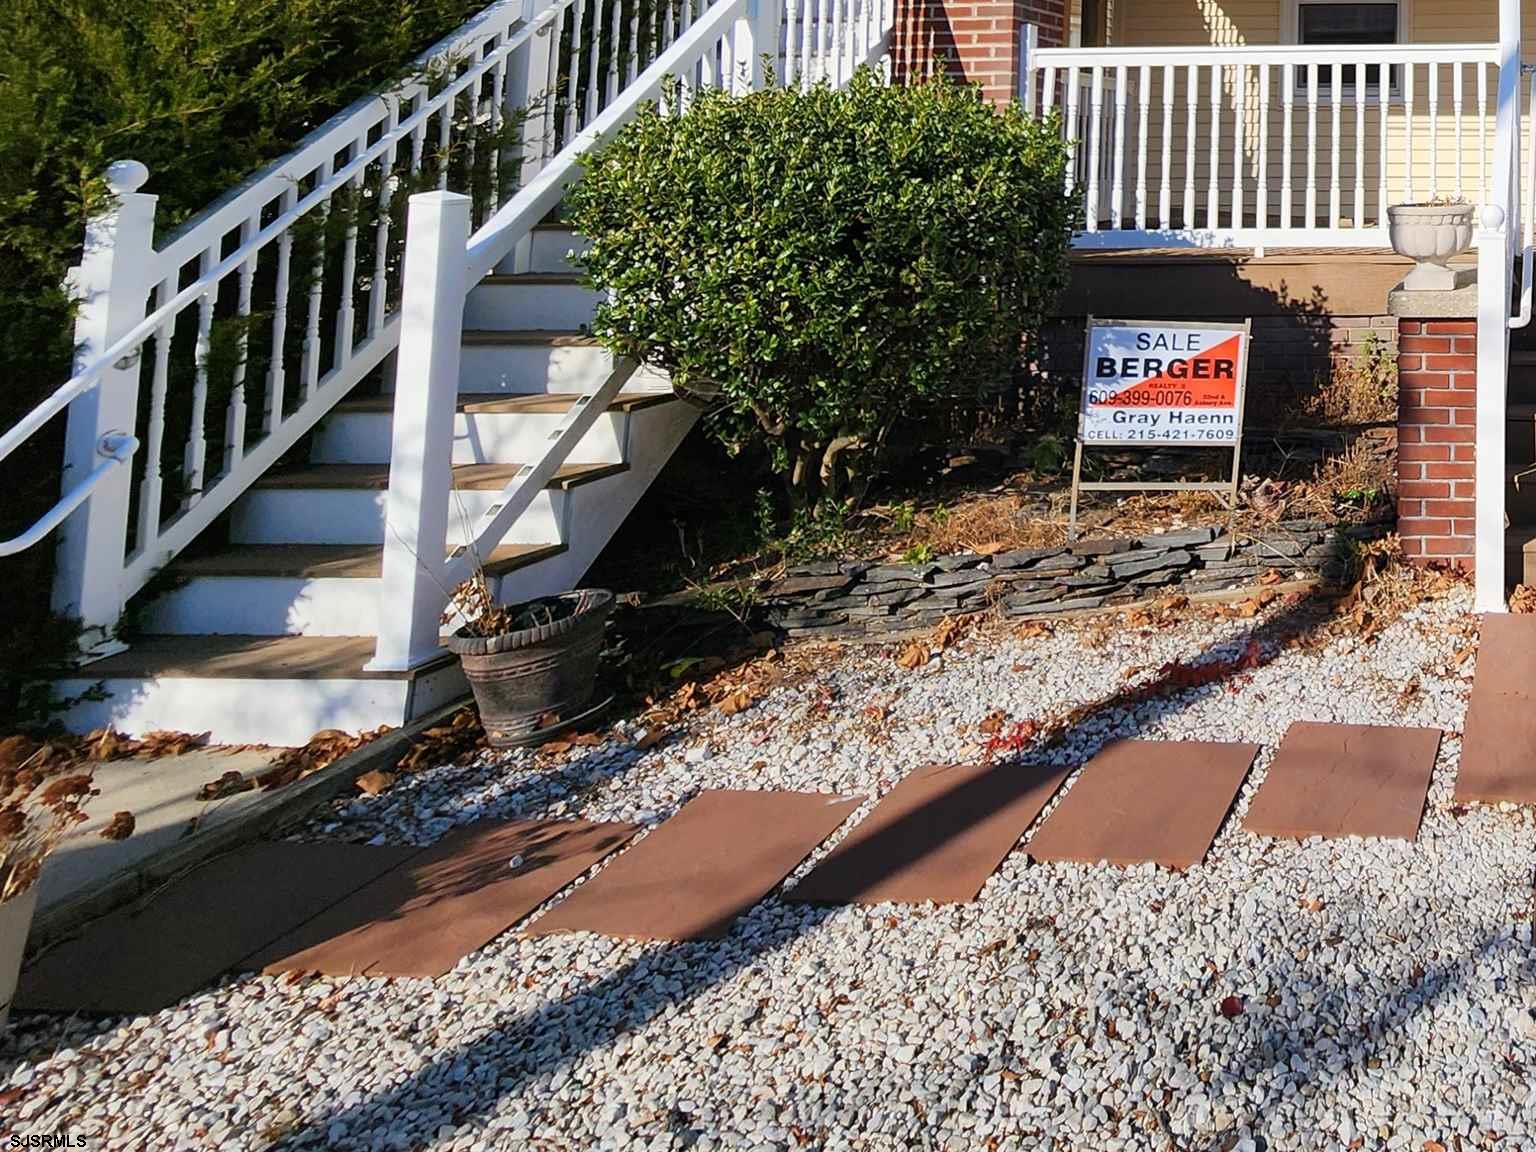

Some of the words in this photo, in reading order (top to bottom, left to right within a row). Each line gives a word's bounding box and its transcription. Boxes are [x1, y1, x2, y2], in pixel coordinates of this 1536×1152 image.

[1136, 332, 1200, 351] SALE
[1095, 357, 1235, 379] BERGER
[1088, 389, 1193, 406] 609-399-0076
[1112, 410, 1161, 427] Gray
[1168, 410, 1234, 424] Haenn
[1087, 430, 1122, 440] CELL:
[1127, 429, 1235, 440] 215-421-7609
